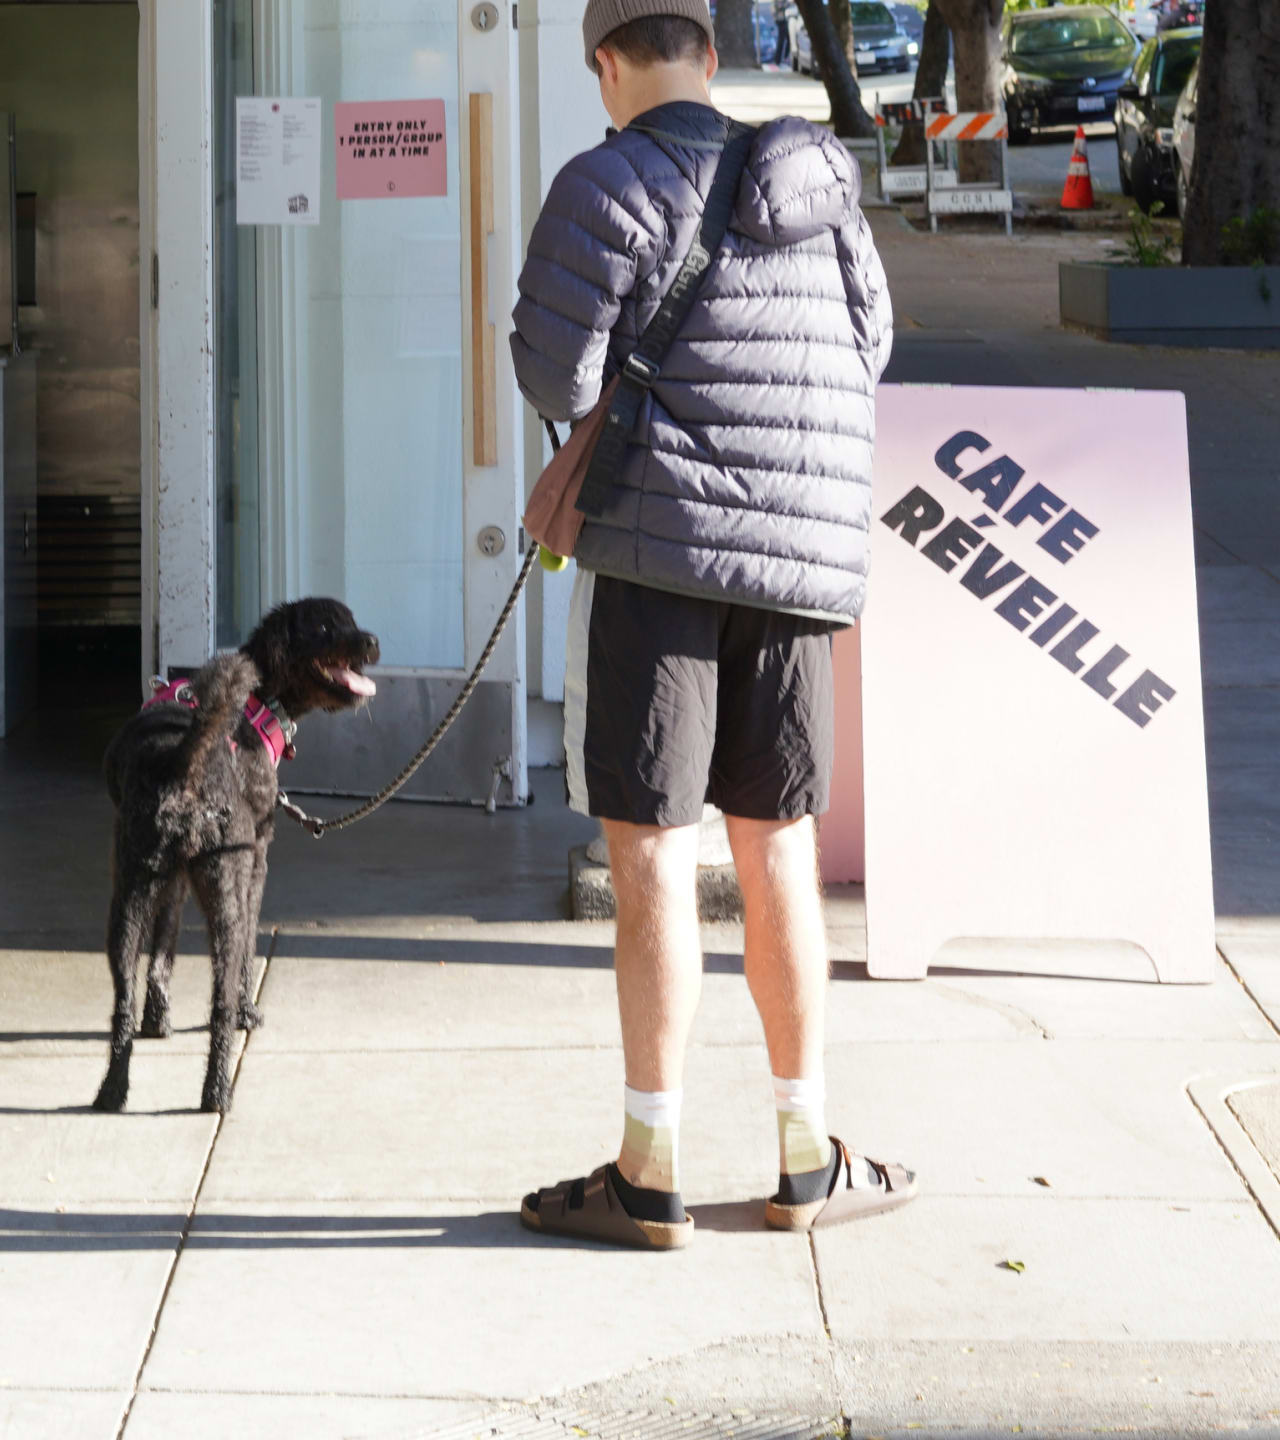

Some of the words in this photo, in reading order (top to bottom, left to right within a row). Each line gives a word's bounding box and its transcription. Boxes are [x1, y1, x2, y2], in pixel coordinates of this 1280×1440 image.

[354, 121, 392, 132] ENTRY
[397, 120, 426, 131] ONLY
[339, 136, 345, 146] 1
[348, 132, 443, 146] PERSON/GROUP
[353, 147, 366, 159] IN
[369, 147, 384, 158] AT
[389, 147, 396, 157] A
[401, 145, 429, 157] TIME
[934, 430, 1101, 565] CAFE
[879, 485, 1177, 729] RÉVEILLE
